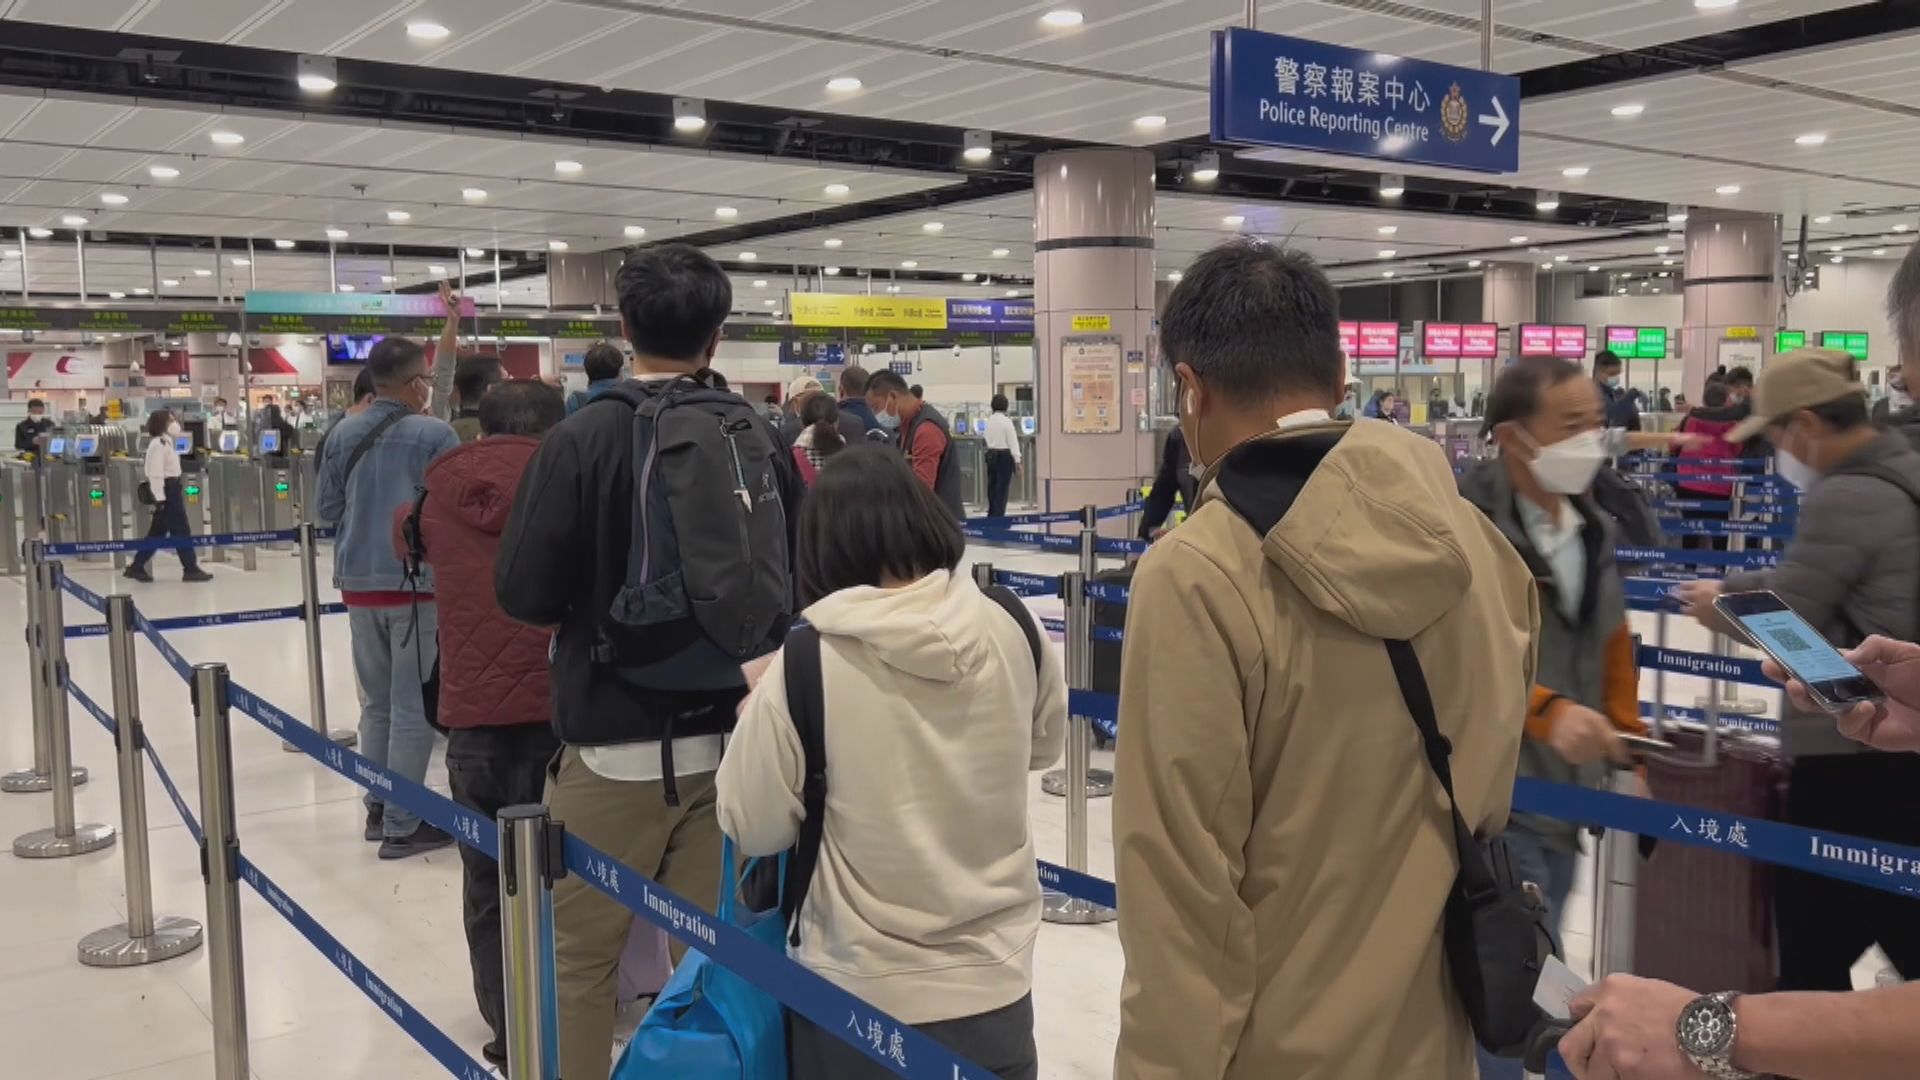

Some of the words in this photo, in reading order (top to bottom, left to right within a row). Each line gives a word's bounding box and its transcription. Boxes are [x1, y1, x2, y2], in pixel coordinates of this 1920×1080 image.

[1274, 56, 1430, 114] 警察報案中心
[1260, 98, 1305, 125] Police
[1310, 107, 1380, 139] Reporting
[1384, 116, 1429, 143] Centre
[233, 532, 277, 542] Immigration
[1721, 522, 1767, 532] Immigration
[75, 543, 125, 553] Immigration
[1658, 650, 1741, 676] Immigration
[354, 759, 393, 792] Immigration
[452, 816, 481, 844] 入境處
[1670, 813, 1751, 849] 入境處
[584, 855, 620, 894] 入境處
[643, 884, 717, 947] Immigration
[365, 972, 404, 1019] Immigration
[847, 1008, 907, 1068] 入境處
